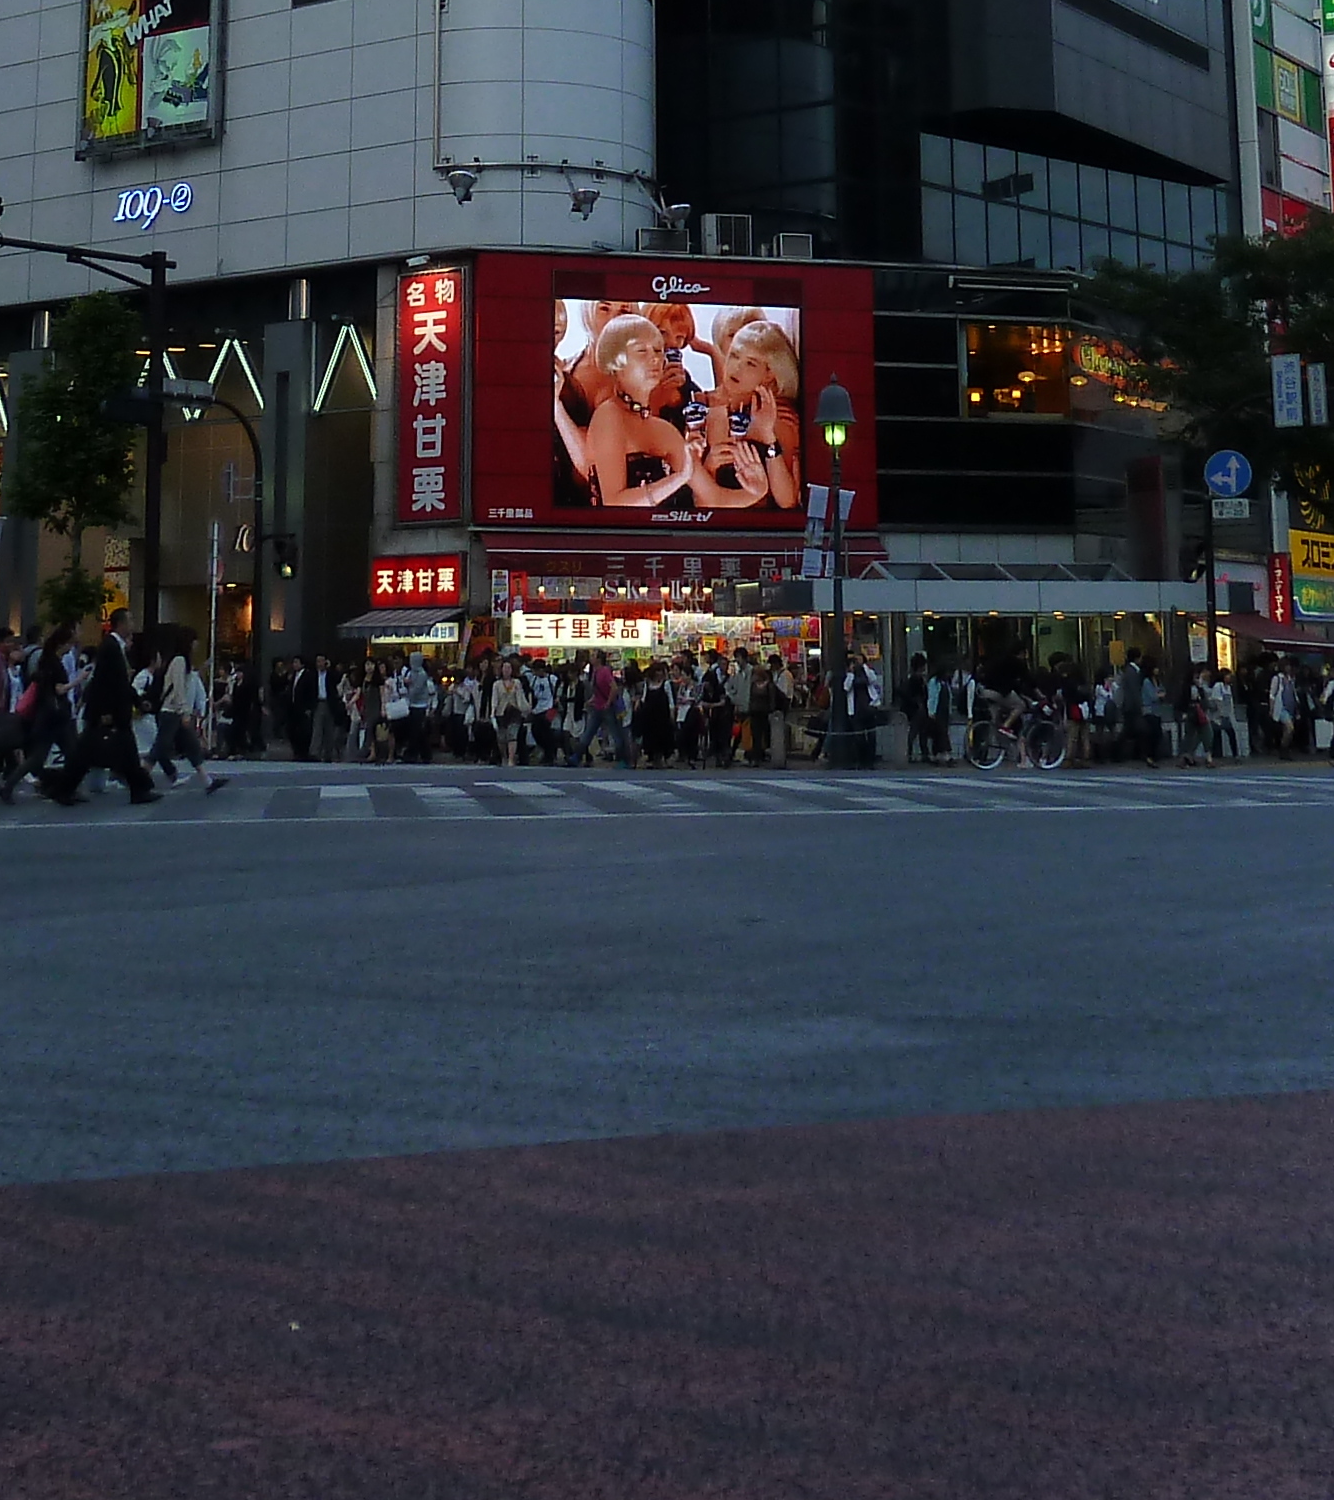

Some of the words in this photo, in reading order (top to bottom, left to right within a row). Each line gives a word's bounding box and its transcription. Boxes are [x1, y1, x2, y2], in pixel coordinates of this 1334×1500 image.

[407, 278, 455, 307] 名物
[652, 276, 711, 300] Glico
[412, 310, 448, 512] 天津甘栗
[488, 507, 534, 520] 三千里薬品
[605, 556, 778, 580] 三千里薬品
[375, 567, 455, 595] 天津甘栗
[523, 617, 640, 639] 三千里薬品
